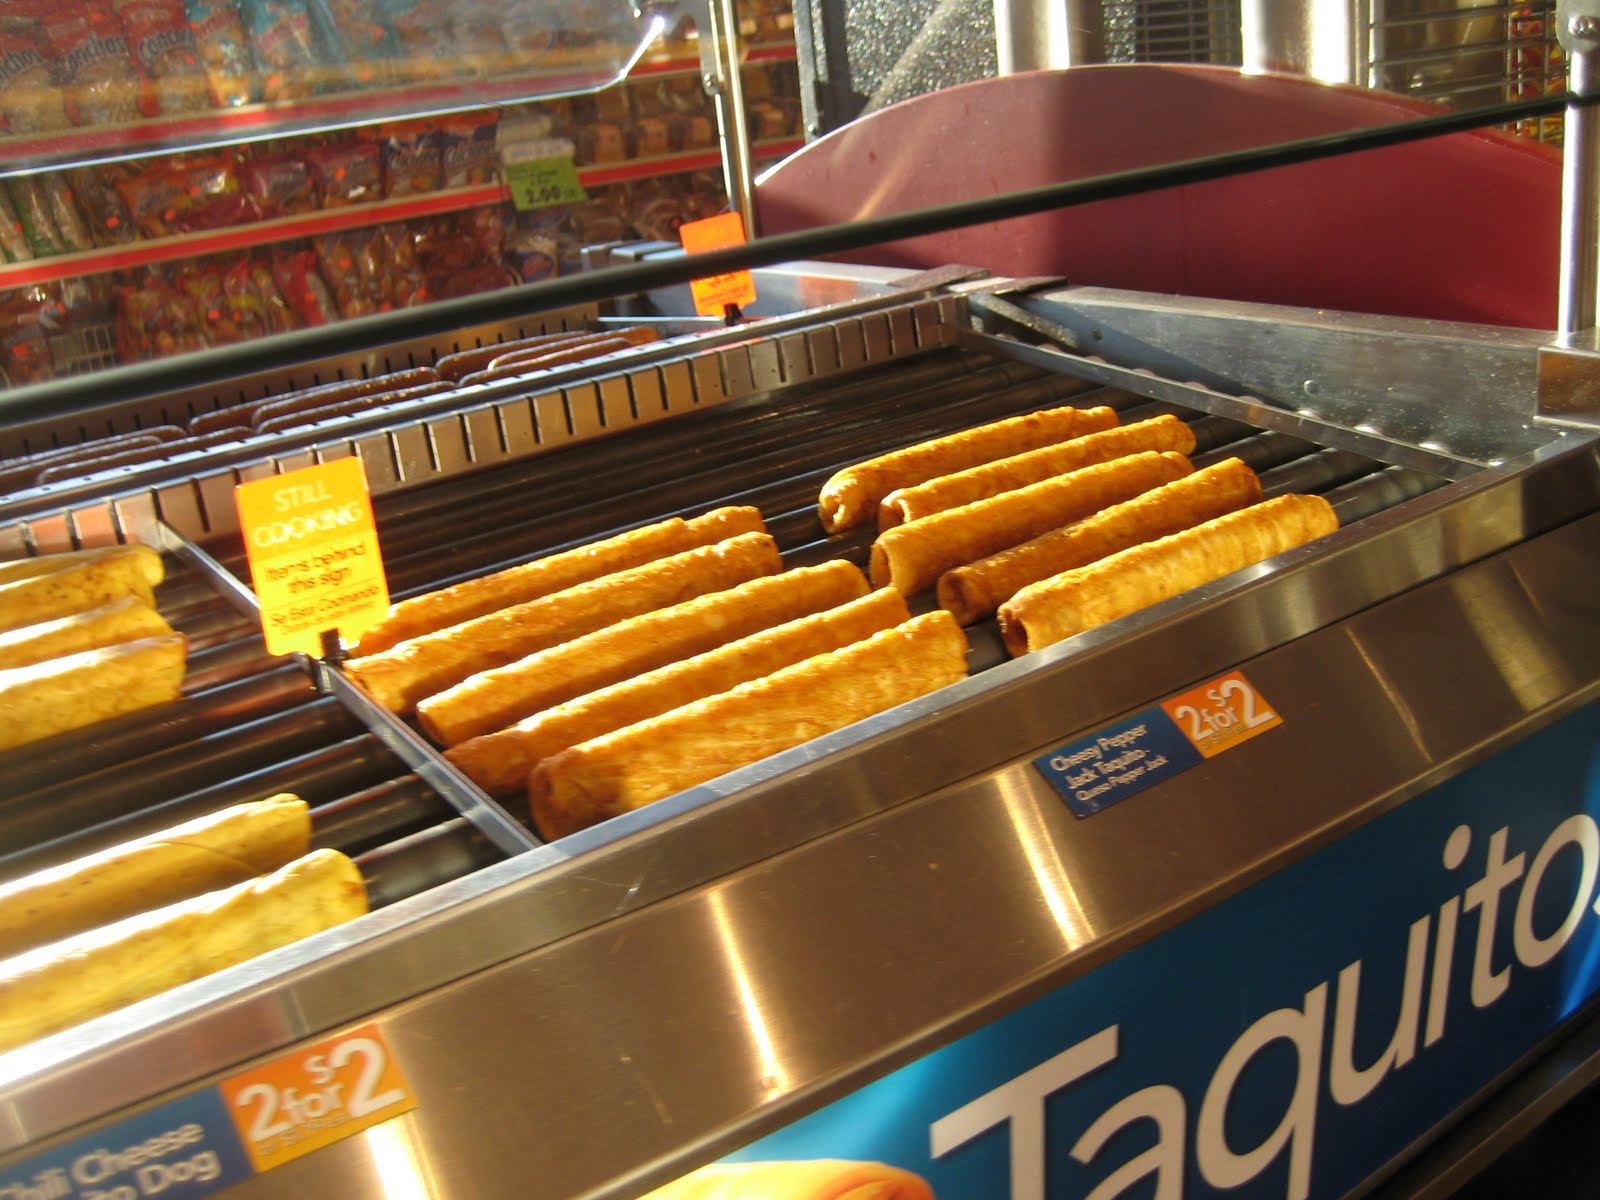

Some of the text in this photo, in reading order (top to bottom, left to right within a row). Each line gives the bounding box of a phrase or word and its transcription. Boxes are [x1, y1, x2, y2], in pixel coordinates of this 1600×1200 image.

[273, 480, 333, 511] STILL
[253, 502, 362, 547] COOKING
[313, 545, 366, 566] behind
[288, 567, 351, 594] this sign
[1176, 705, 1214, 741] 2
[1201, 707, 1239, 731] for
[1049, 723, 1148, 772] Cheesy Pepper
[1064, 765, 1100, 790] Jack
[1109, 765, 1146, 787] Pepper
[1145, 753, 1169, 772] Jack
[930, 814, 1600, 1200] Taquito
[236, 1083, 290, 1142] 2
[281, 1083, 345, 1125] for
[71, 1123, 205, 1185] Cheese
[136, 1150, 222, 1196] Dog
